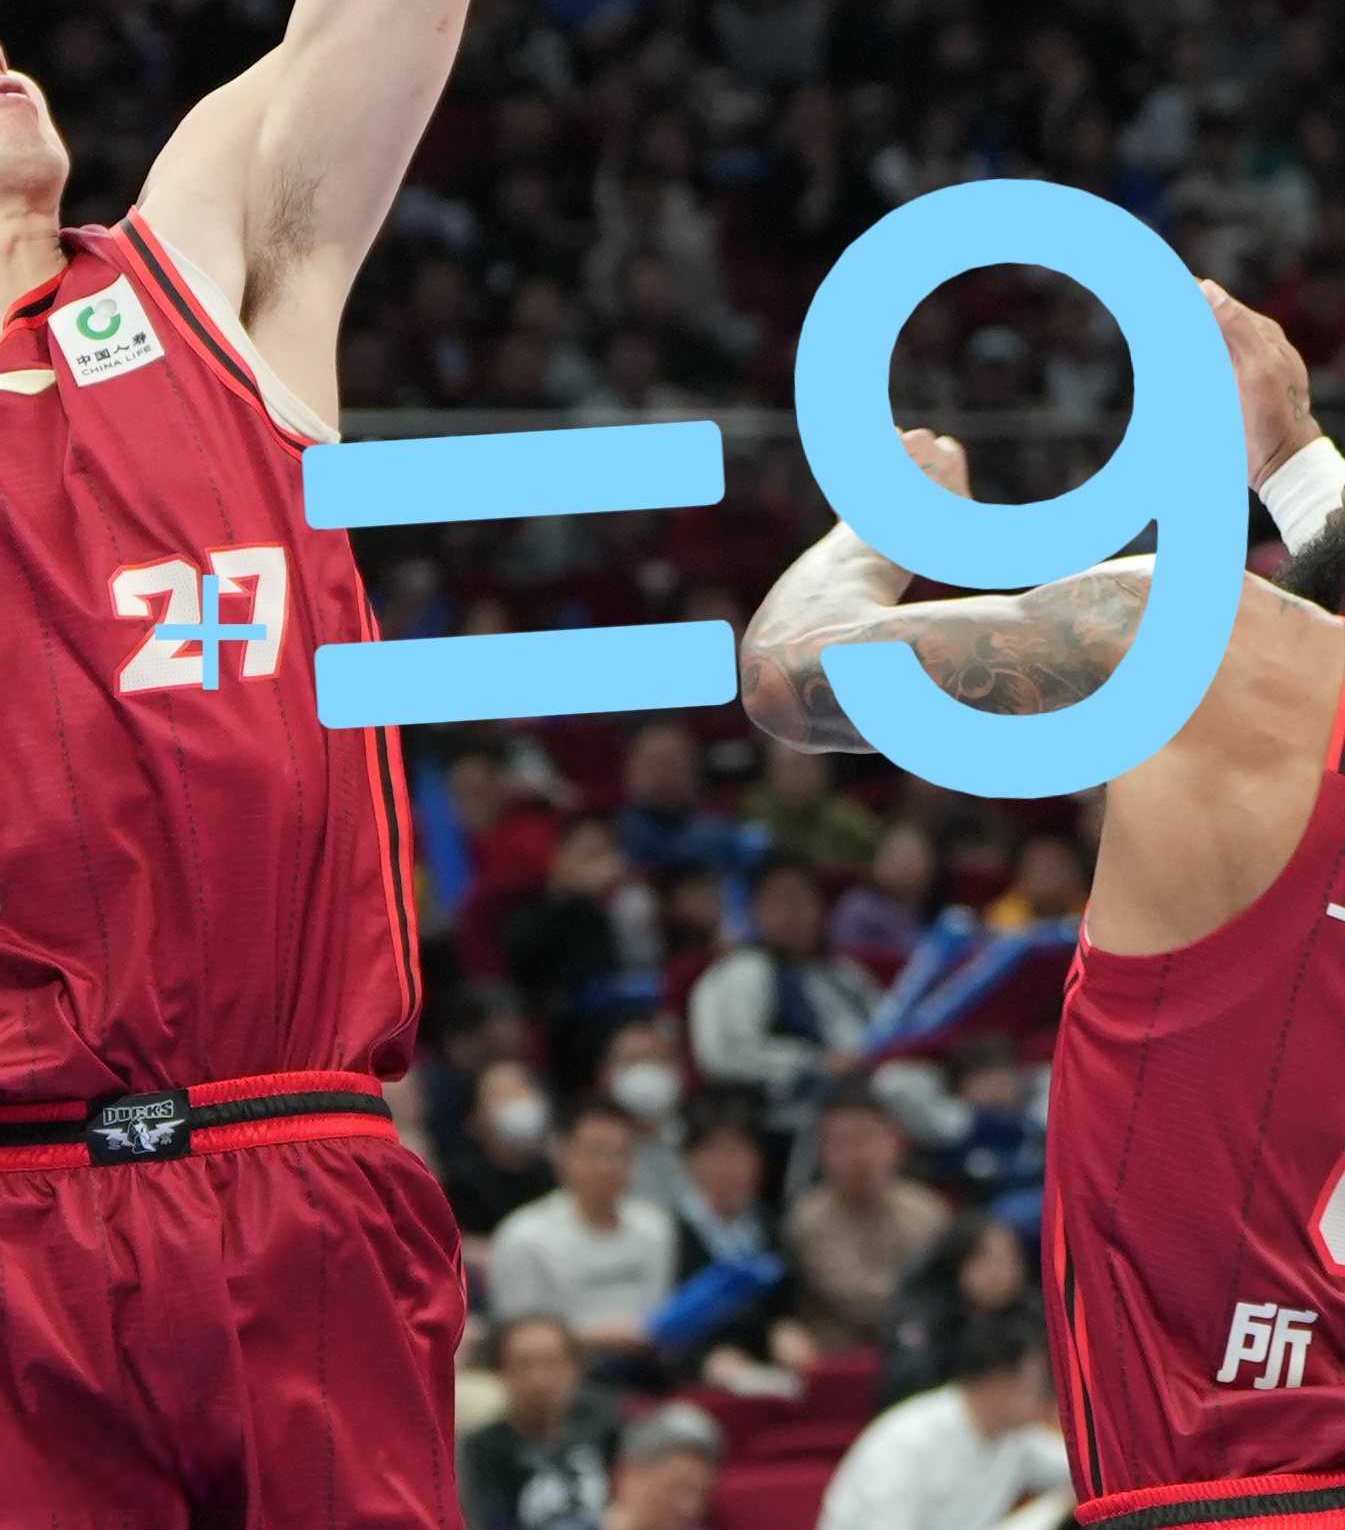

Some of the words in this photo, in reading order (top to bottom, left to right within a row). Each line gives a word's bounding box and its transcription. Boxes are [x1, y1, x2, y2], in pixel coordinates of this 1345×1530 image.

[76, 332, 147, 367] 中国人寿
[82, 359, 122, 376] CHINA
[125, 345, 152, 362] LIFE
[109, 543, 289, 696] 27
[103, 1099, 174, 1126] DUCKS
[1216, 1302, 1319, 1390] 所
